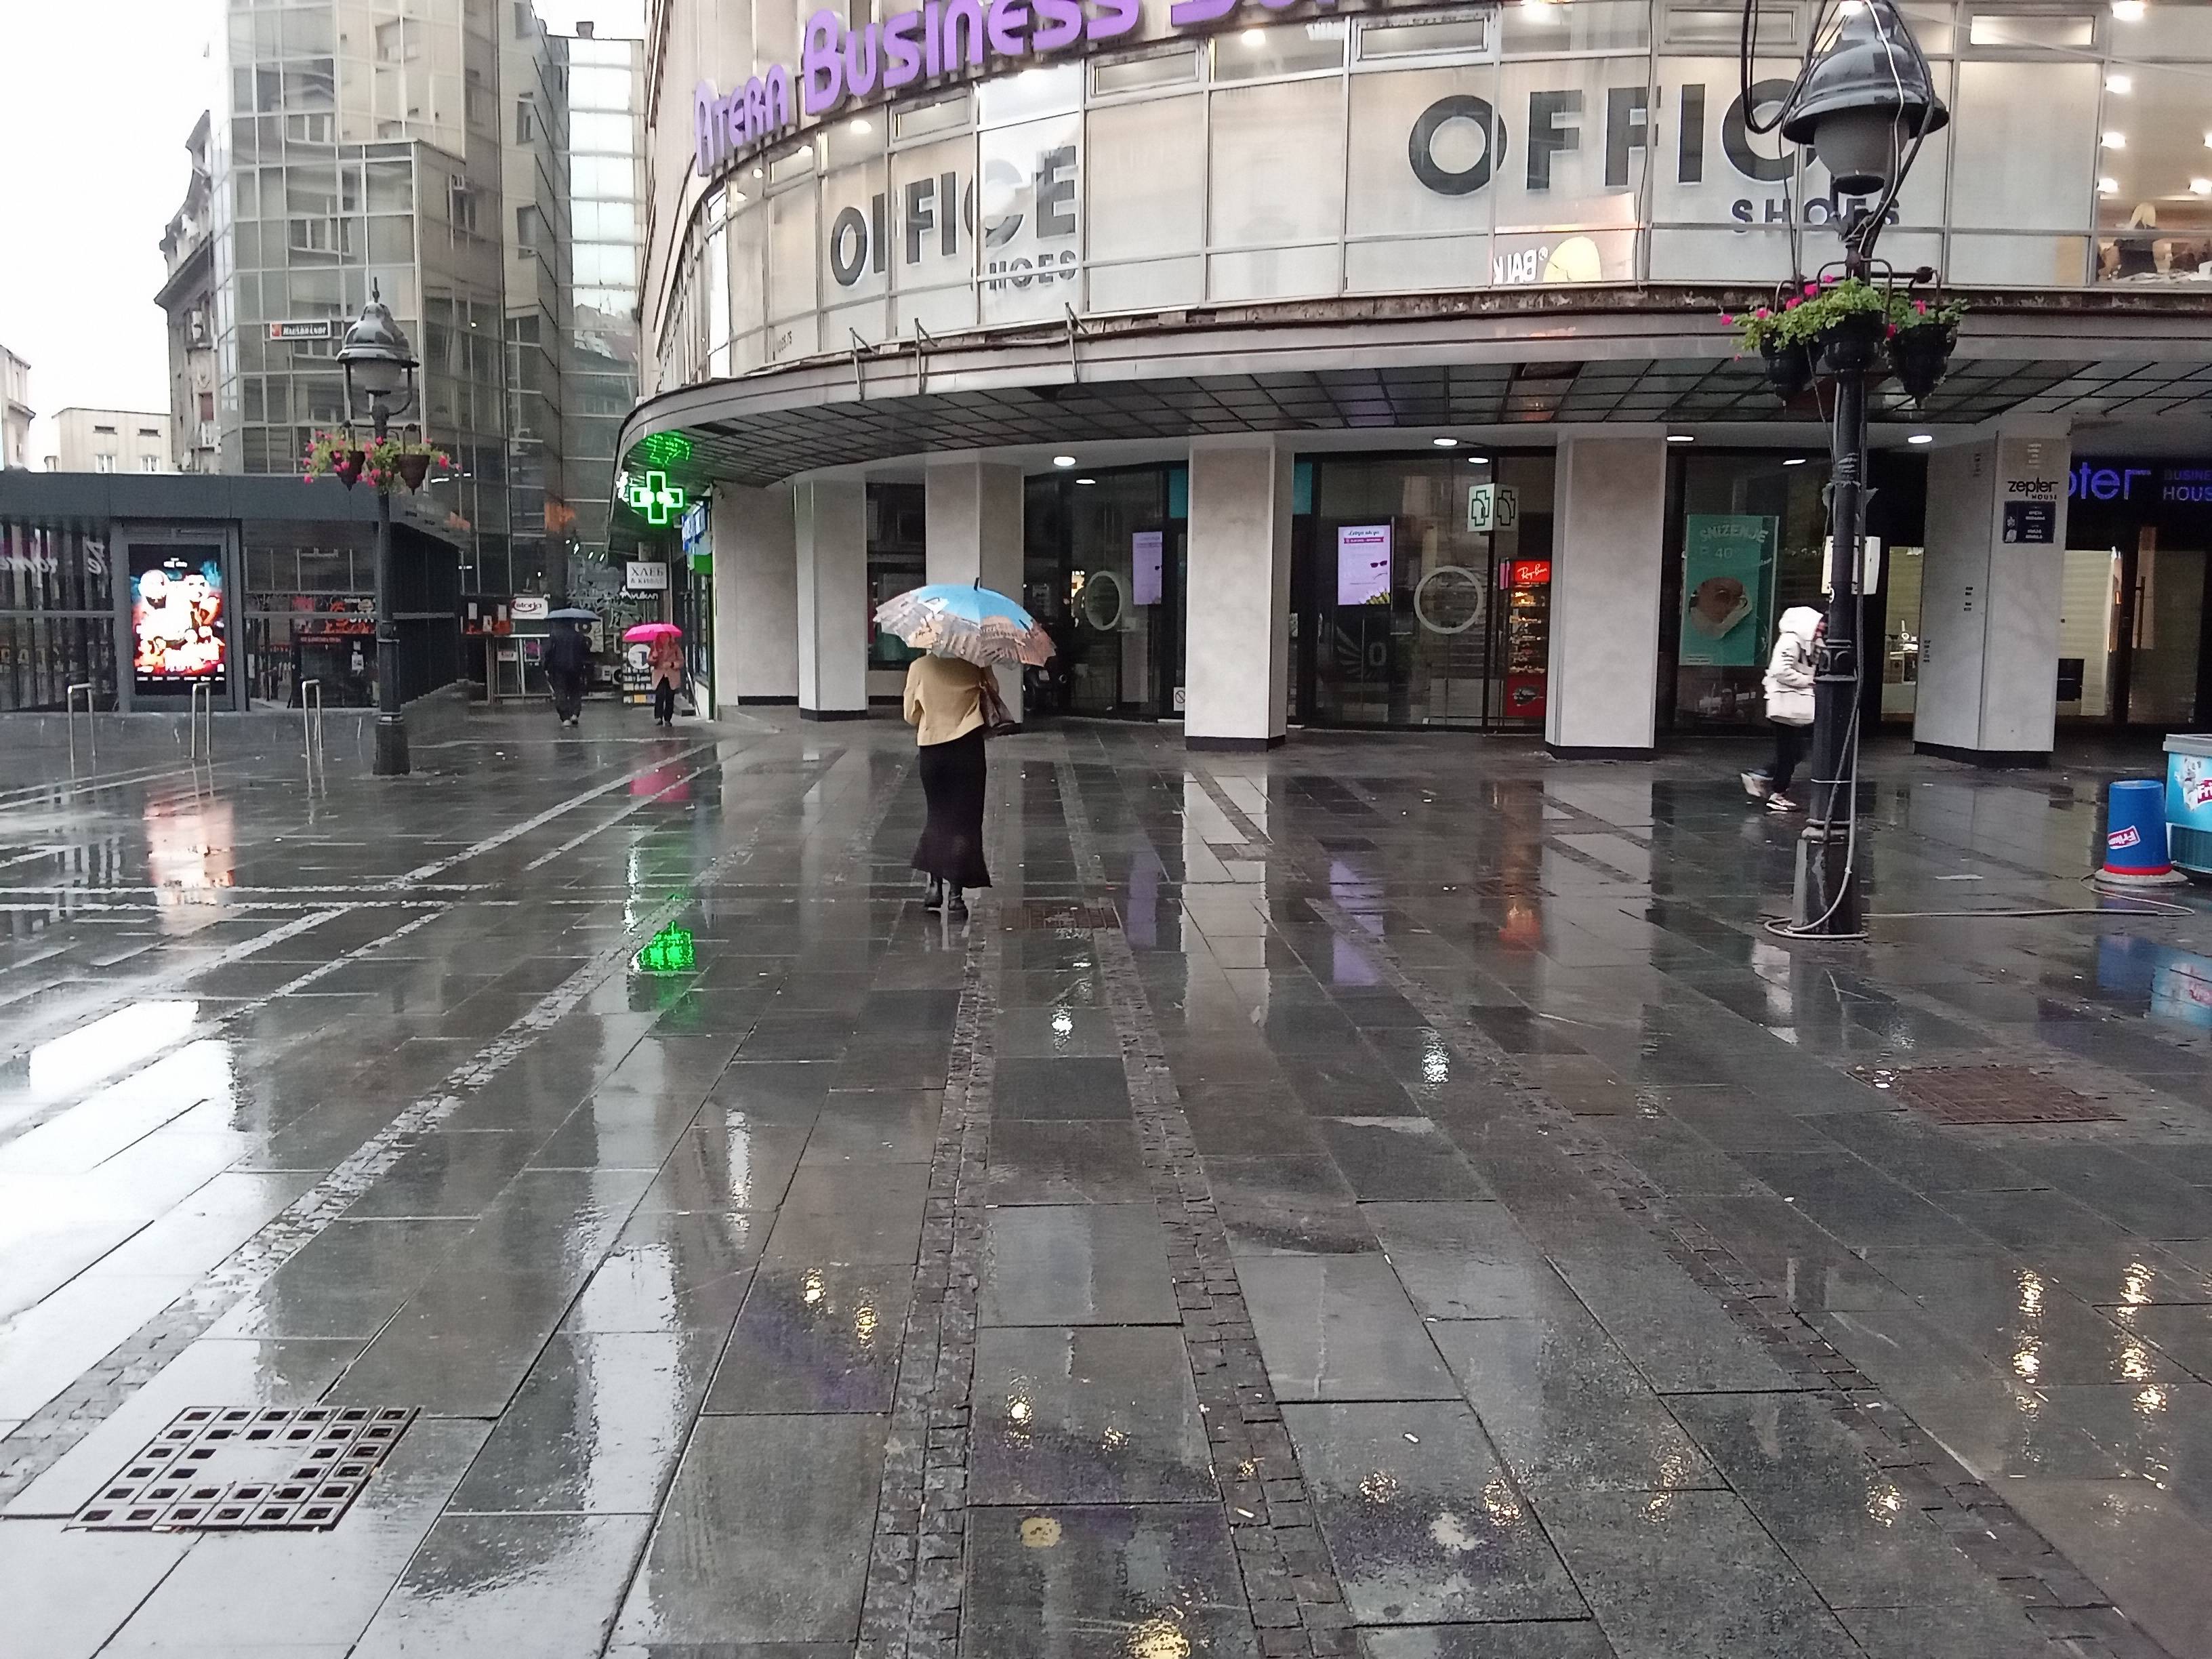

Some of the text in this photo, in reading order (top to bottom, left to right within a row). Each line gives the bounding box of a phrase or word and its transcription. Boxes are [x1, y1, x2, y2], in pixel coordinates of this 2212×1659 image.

[1408, 79, 1819, 196] OFFIC
[970, 249, 1077, 292] HOES
[2007, 476, 2059, 497] zepter
[1517, 563, 1548, 581] Ray-Ban
